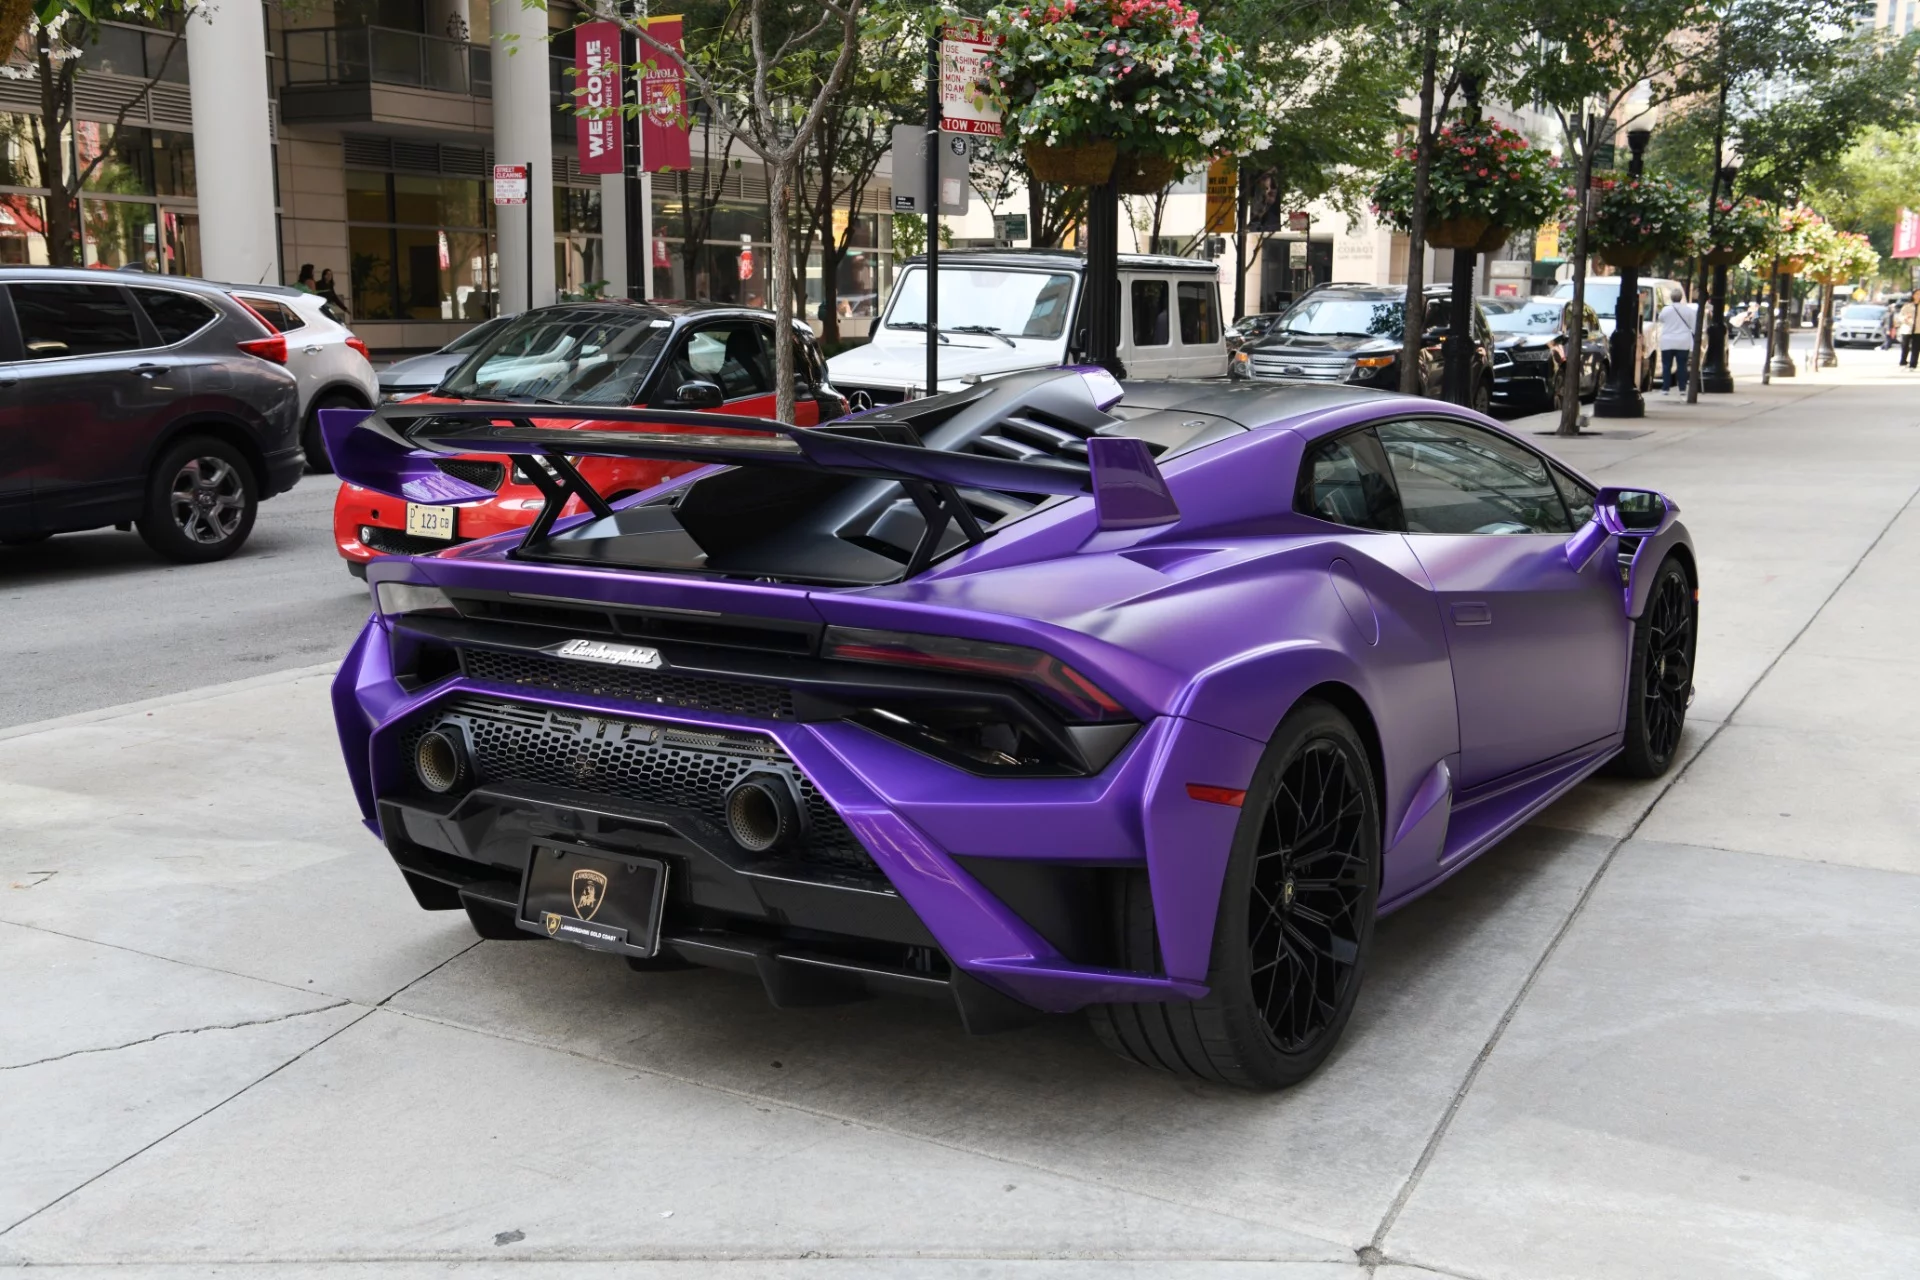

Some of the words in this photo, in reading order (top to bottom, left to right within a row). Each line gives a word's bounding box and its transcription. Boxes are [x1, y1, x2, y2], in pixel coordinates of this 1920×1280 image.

[946, 45, 960, 54] USE
[604, 46, 612, 85] CUS
[646, 69, 679, 80] LOYOLA
[945, 74, 961, 83] MON
[945, 93, 957, 102] FRI
[945, 118, 968, 131] TOW
[605, 120, 614, 150] WATER
[421, 513, 437, 530] 123
[562, 639, 657, 665] Lamborghini
[561, 923, 590, 937] LAMBORGHINI
[590, 930, 603, 940] GOLD
[602, 932, 617, 942] COAST
